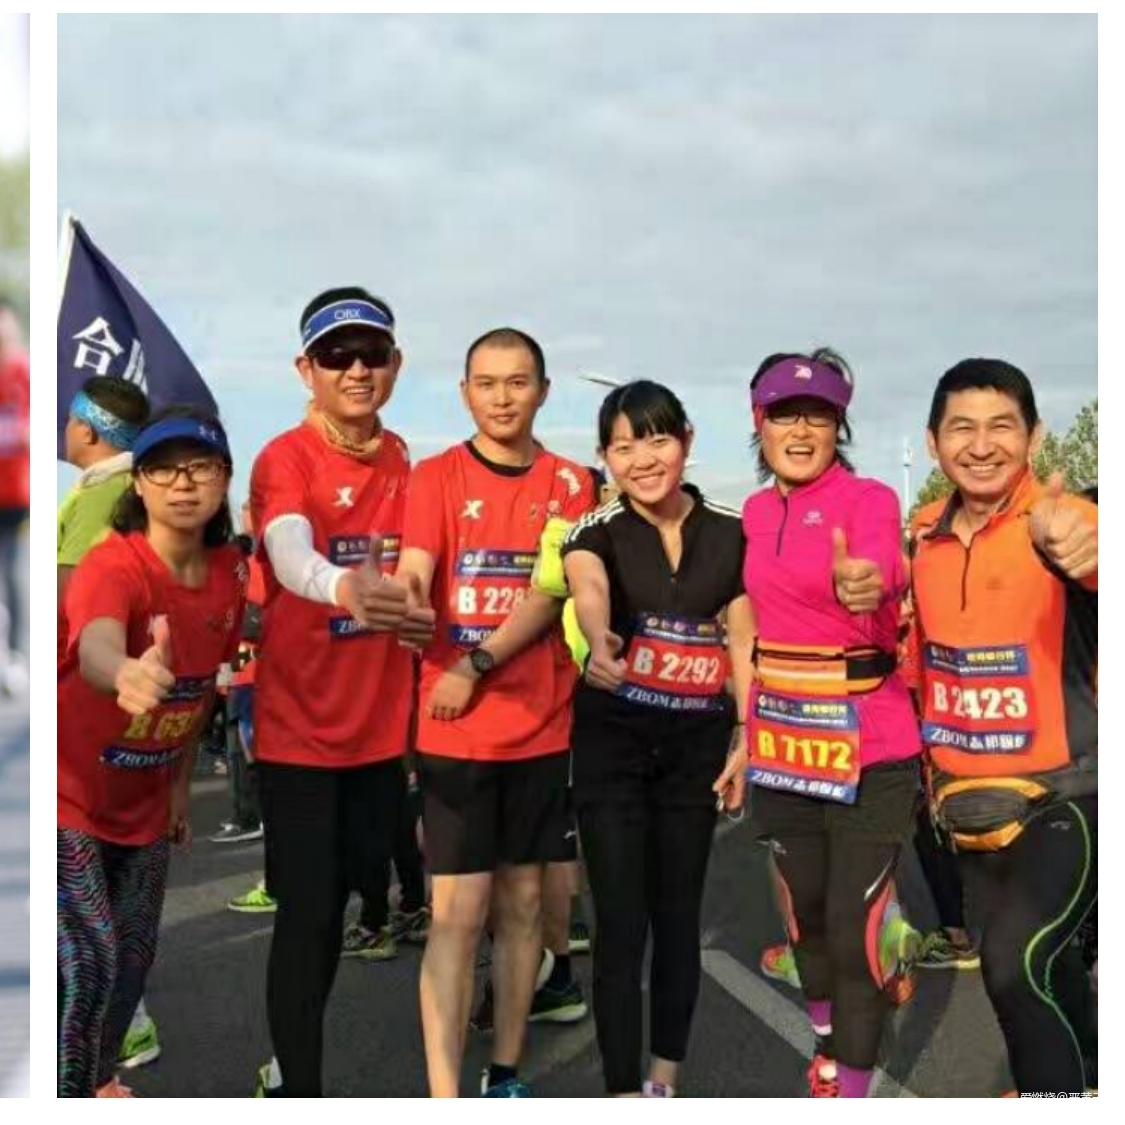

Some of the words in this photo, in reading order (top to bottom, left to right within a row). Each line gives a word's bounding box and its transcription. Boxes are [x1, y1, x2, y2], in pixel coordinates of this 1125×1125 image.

[458, 586, 477, 614] B
[632, 646, 655, 675] B
[658, 651, 720, 685] 2292
[626, 686, 669, 707] ZBOM
[933, 680, 949, 713] B
[951, 685, 1029, 719] 2423
[758, 729, 776, 759] B
[780, 734, 852, 770] 7172
